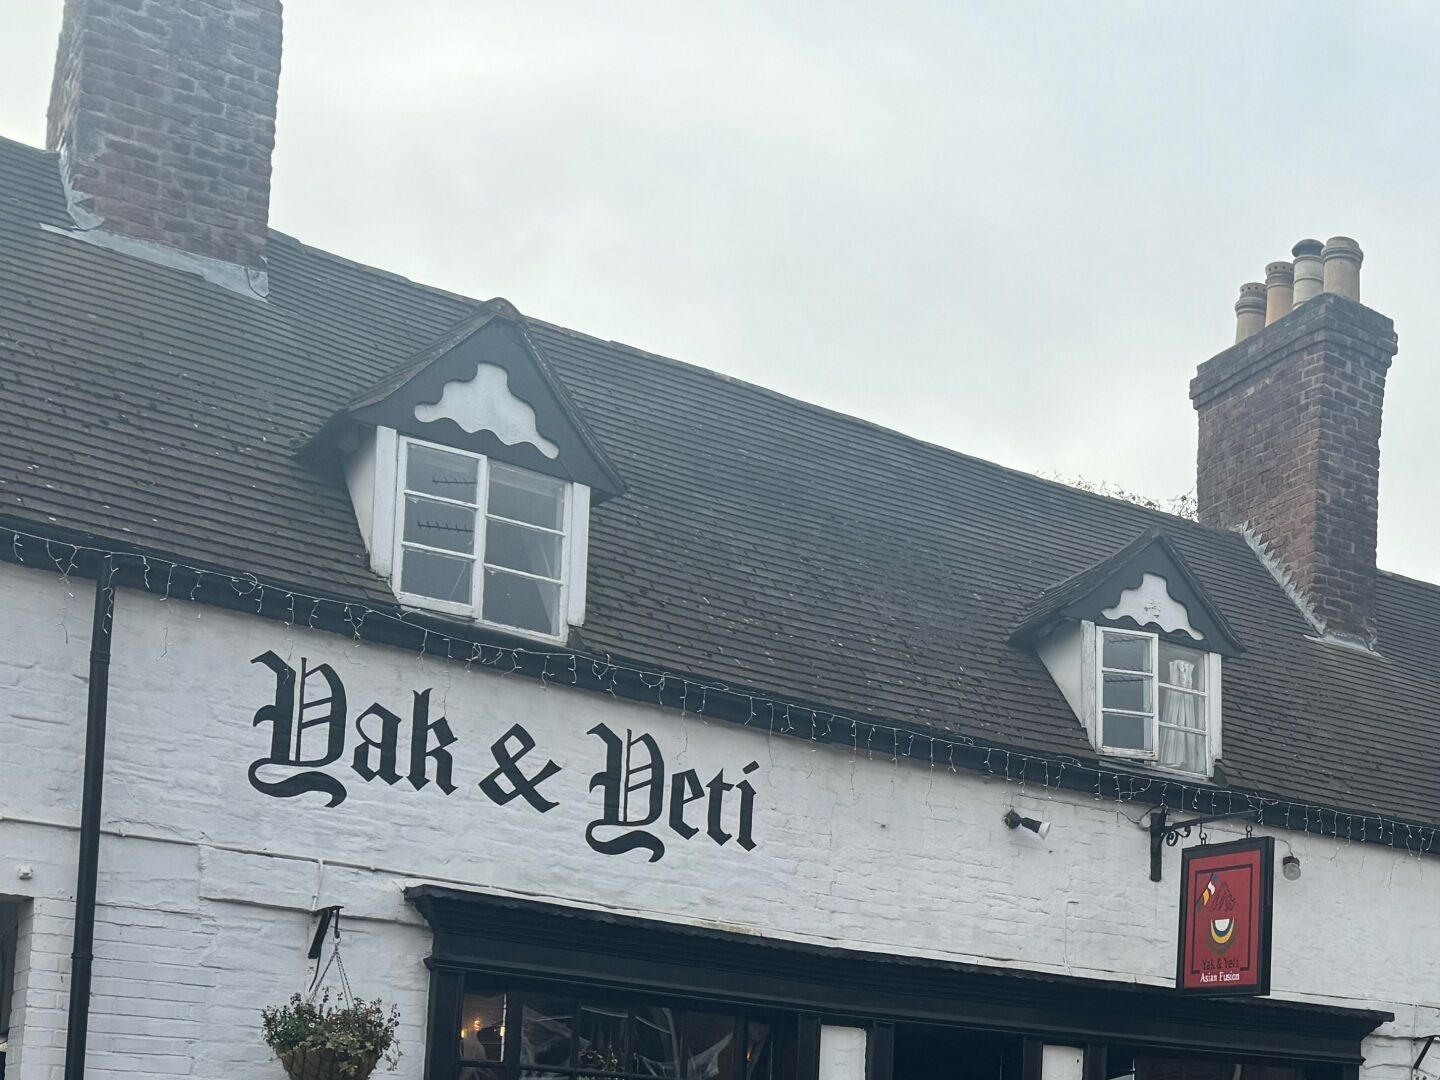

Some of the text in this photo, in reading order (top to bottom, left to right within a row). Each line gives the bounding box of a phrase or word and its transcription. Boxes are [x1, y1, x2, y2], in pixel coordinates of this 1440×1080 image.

[248, 650, 760, 863] Yak & Yeti
[1202, 957, 1239, 970] Yak & Yeti
[1200, 970, 1240, 983] Asian Fusion
